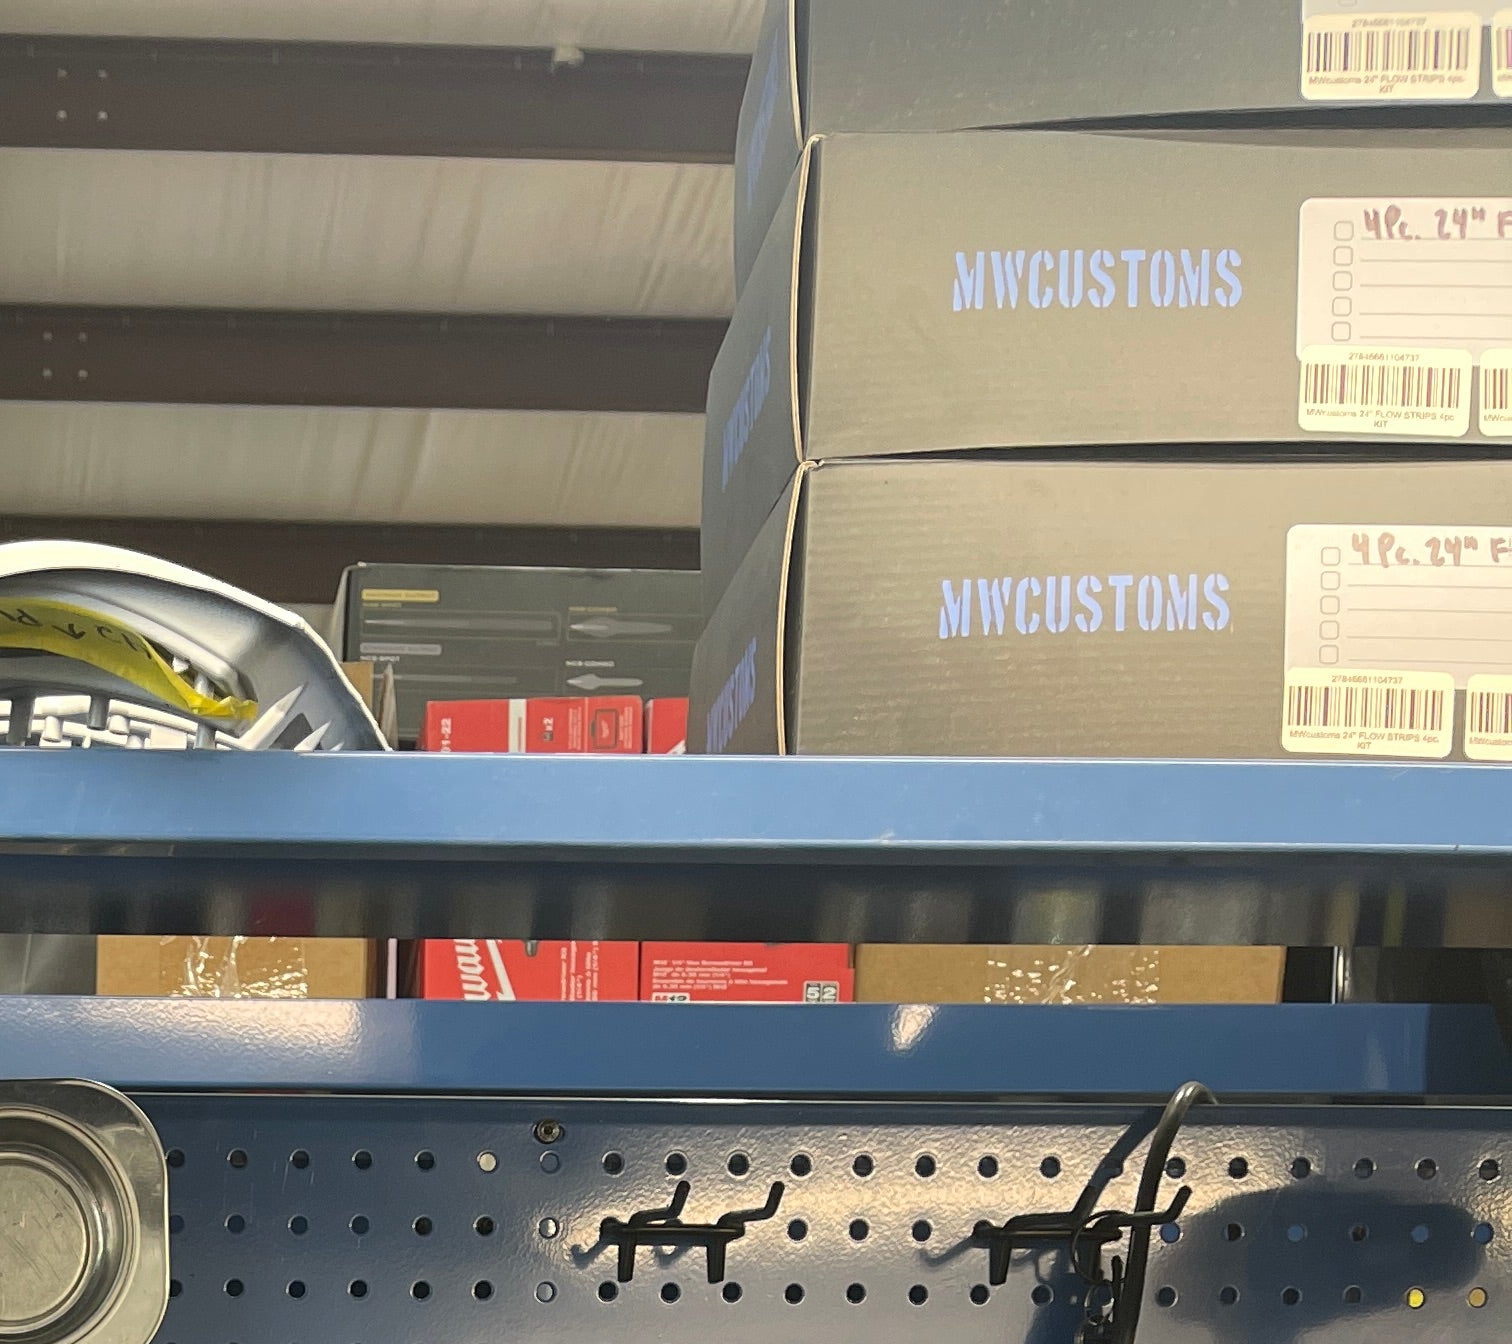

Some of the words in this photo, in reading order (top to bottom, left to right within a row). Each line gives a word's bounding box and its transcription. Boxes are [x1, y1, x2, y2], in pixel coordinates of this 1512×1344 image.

[953, 249, 1242, 312] MWCUSTOMS
[1375, 410, 1402, 419] FLOW
[1404, 411, 1437, 421] STRIPS
[1374, 420, 1388, 429] KIT
[939, 573, 1230, 640] MWCUSTOMS
[1359, 732, 1386, 741] FLOW
[1387, 733, 1420, 743] STRIPS
[1357, 742, 1372, 750] KIT
